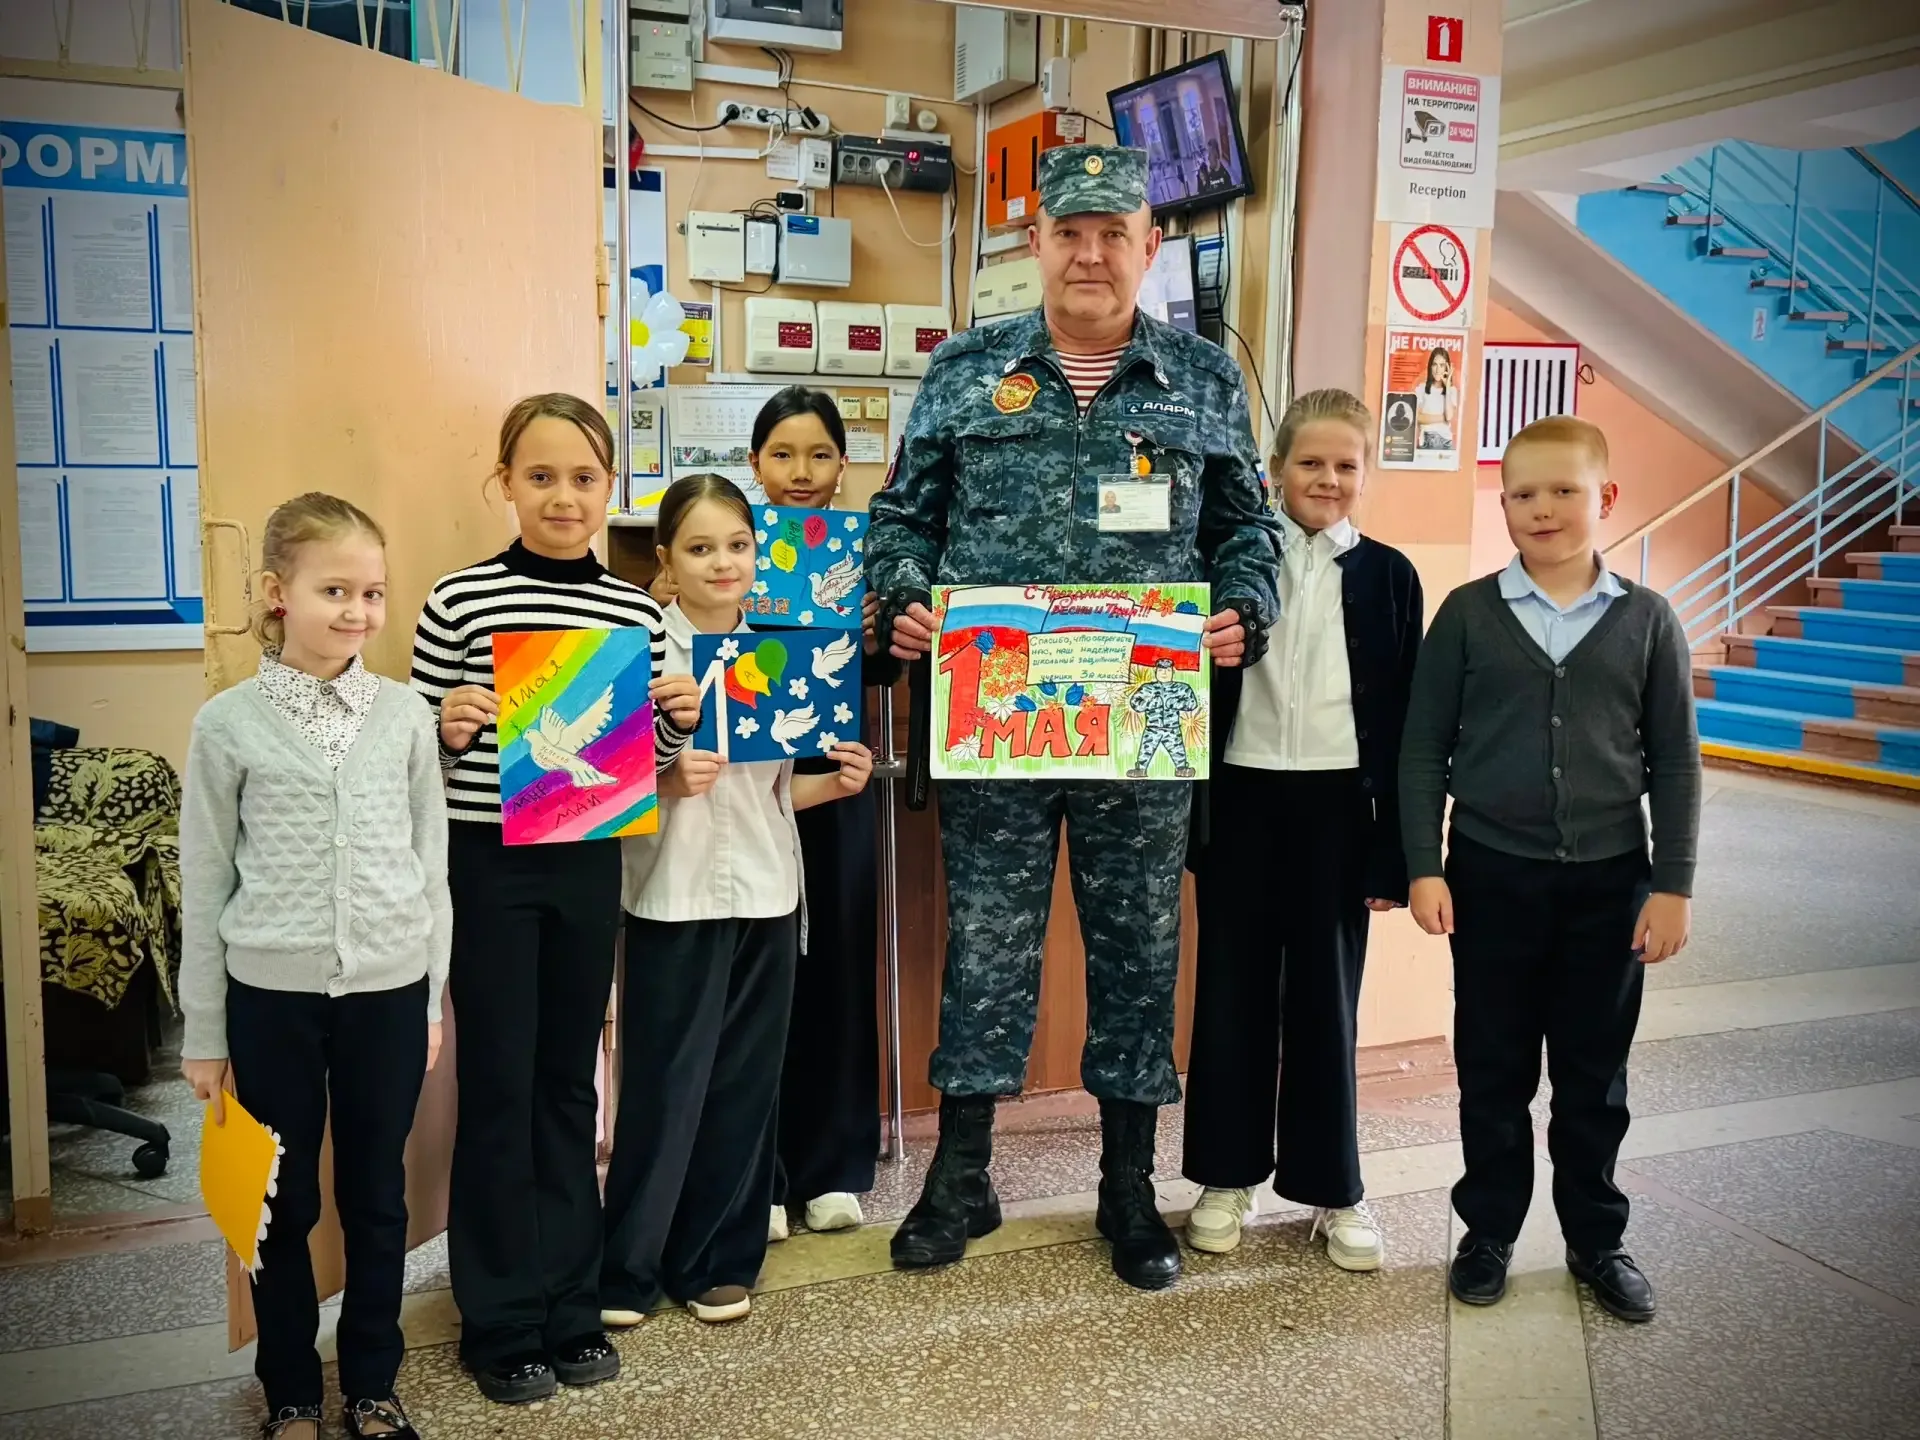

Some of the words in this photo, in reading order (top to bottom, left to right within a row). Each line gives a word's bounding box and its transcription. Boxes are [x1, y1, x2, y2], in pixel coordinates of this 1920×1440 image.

[1407, 77, 1477, 96] ВНИМАНИЕ!
[1407, 97, 1420, 106] НА
[1422, 98, 1475, 112] ТЕРРИТОРИИ
[1449, 126, 1458, 136] 24
[1459, 127, 1474, 138] ЧАСА
[0, 133, 188, 186] ОРМ
[1403, 156, 1473, 169] ВИДЕОНАБЛЮДЕНИЕ
[1409, 182, 1466, 199] Reception
[1390, 336, 1410, 352] НЕ
[1412, 336, 1461, 352] ГОВОРИ
[1003, 378, 1033, 391] ОХРАНА
[1142, 401, 1196, 418] АЛАРМ
[508, 695, 520, 708] 1
[939, 640, 983, 752] 1
[978, 704, 1111, 758] МАЯ
